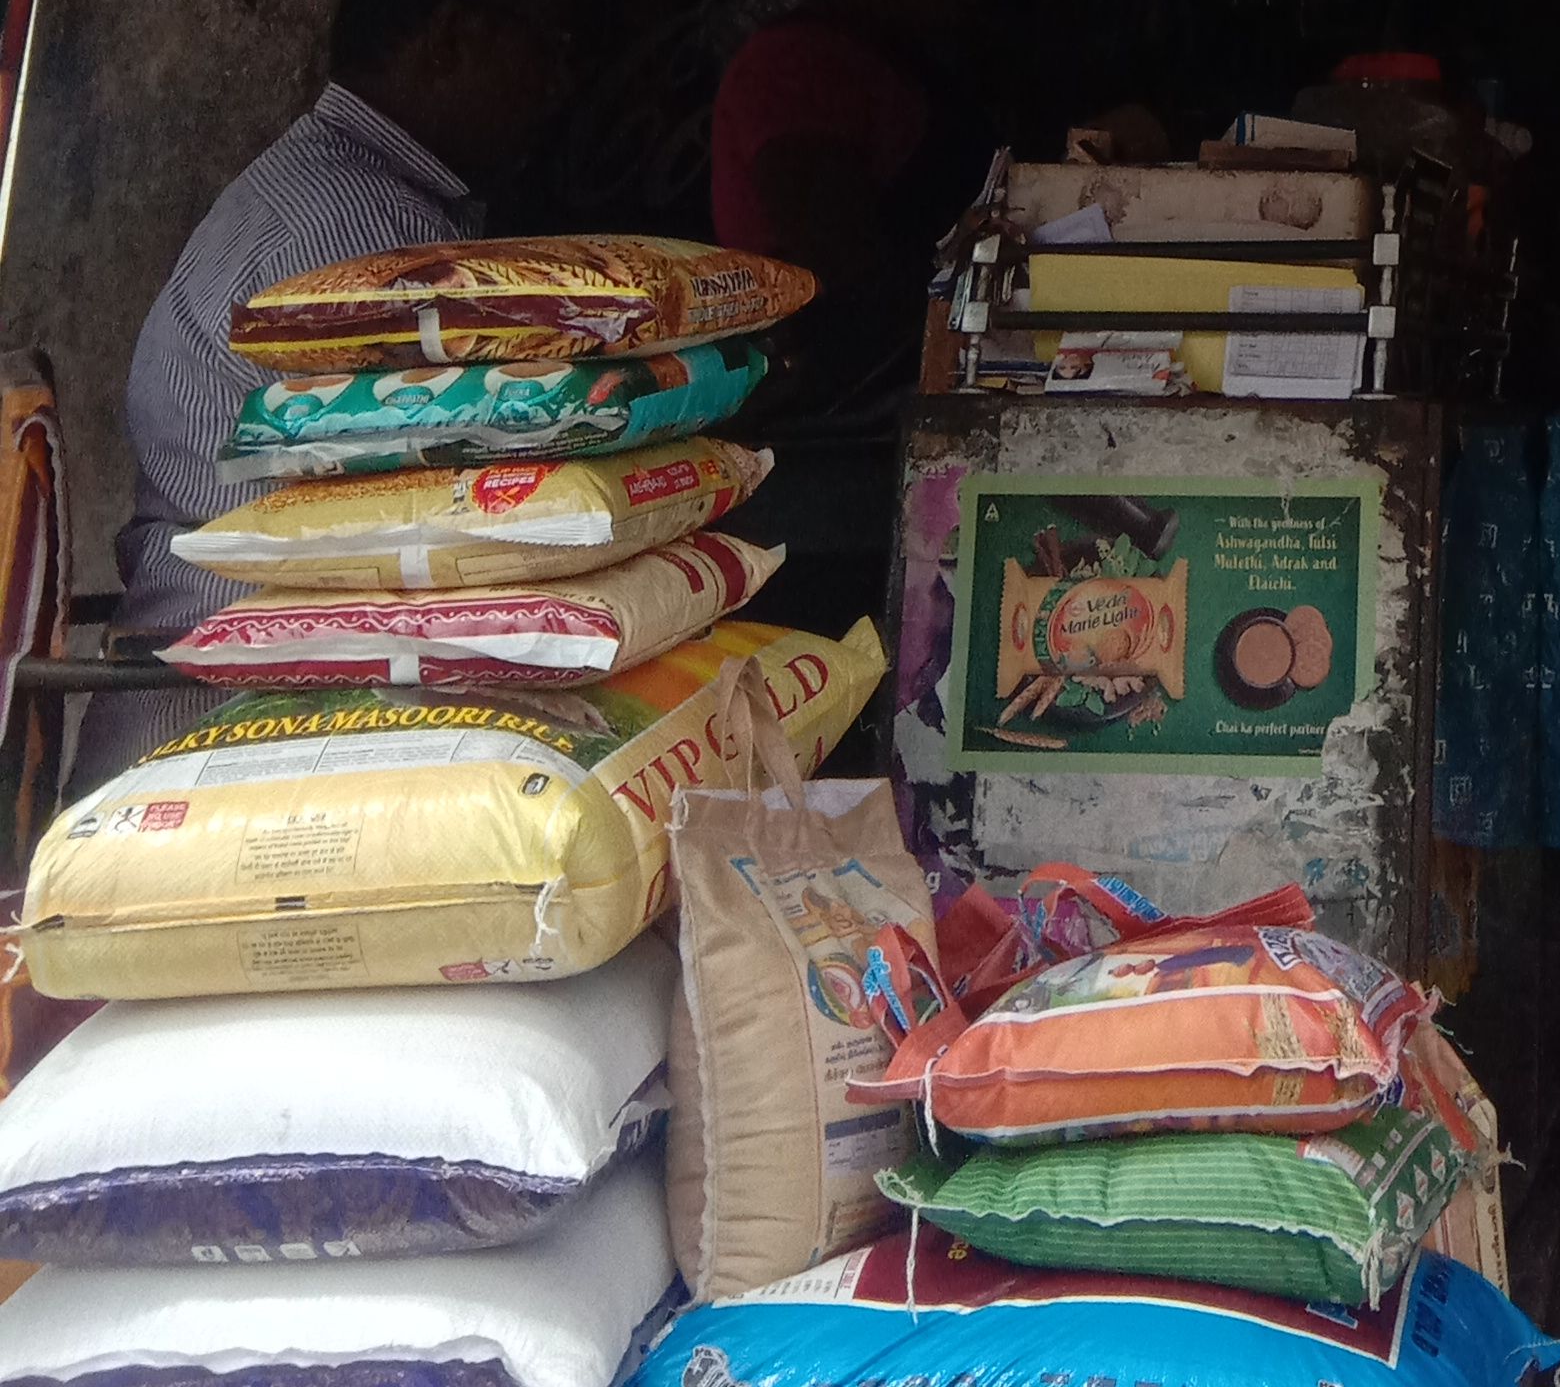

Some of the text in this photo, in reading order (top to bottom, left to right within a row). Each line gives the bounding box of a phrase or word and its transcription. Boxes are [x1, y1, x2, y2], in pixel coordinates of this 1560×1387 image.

[226, 713, 322, 743] SONA
[322, 705, 497, 733] MASOORI
[611, 737, 704, 824] VIP
